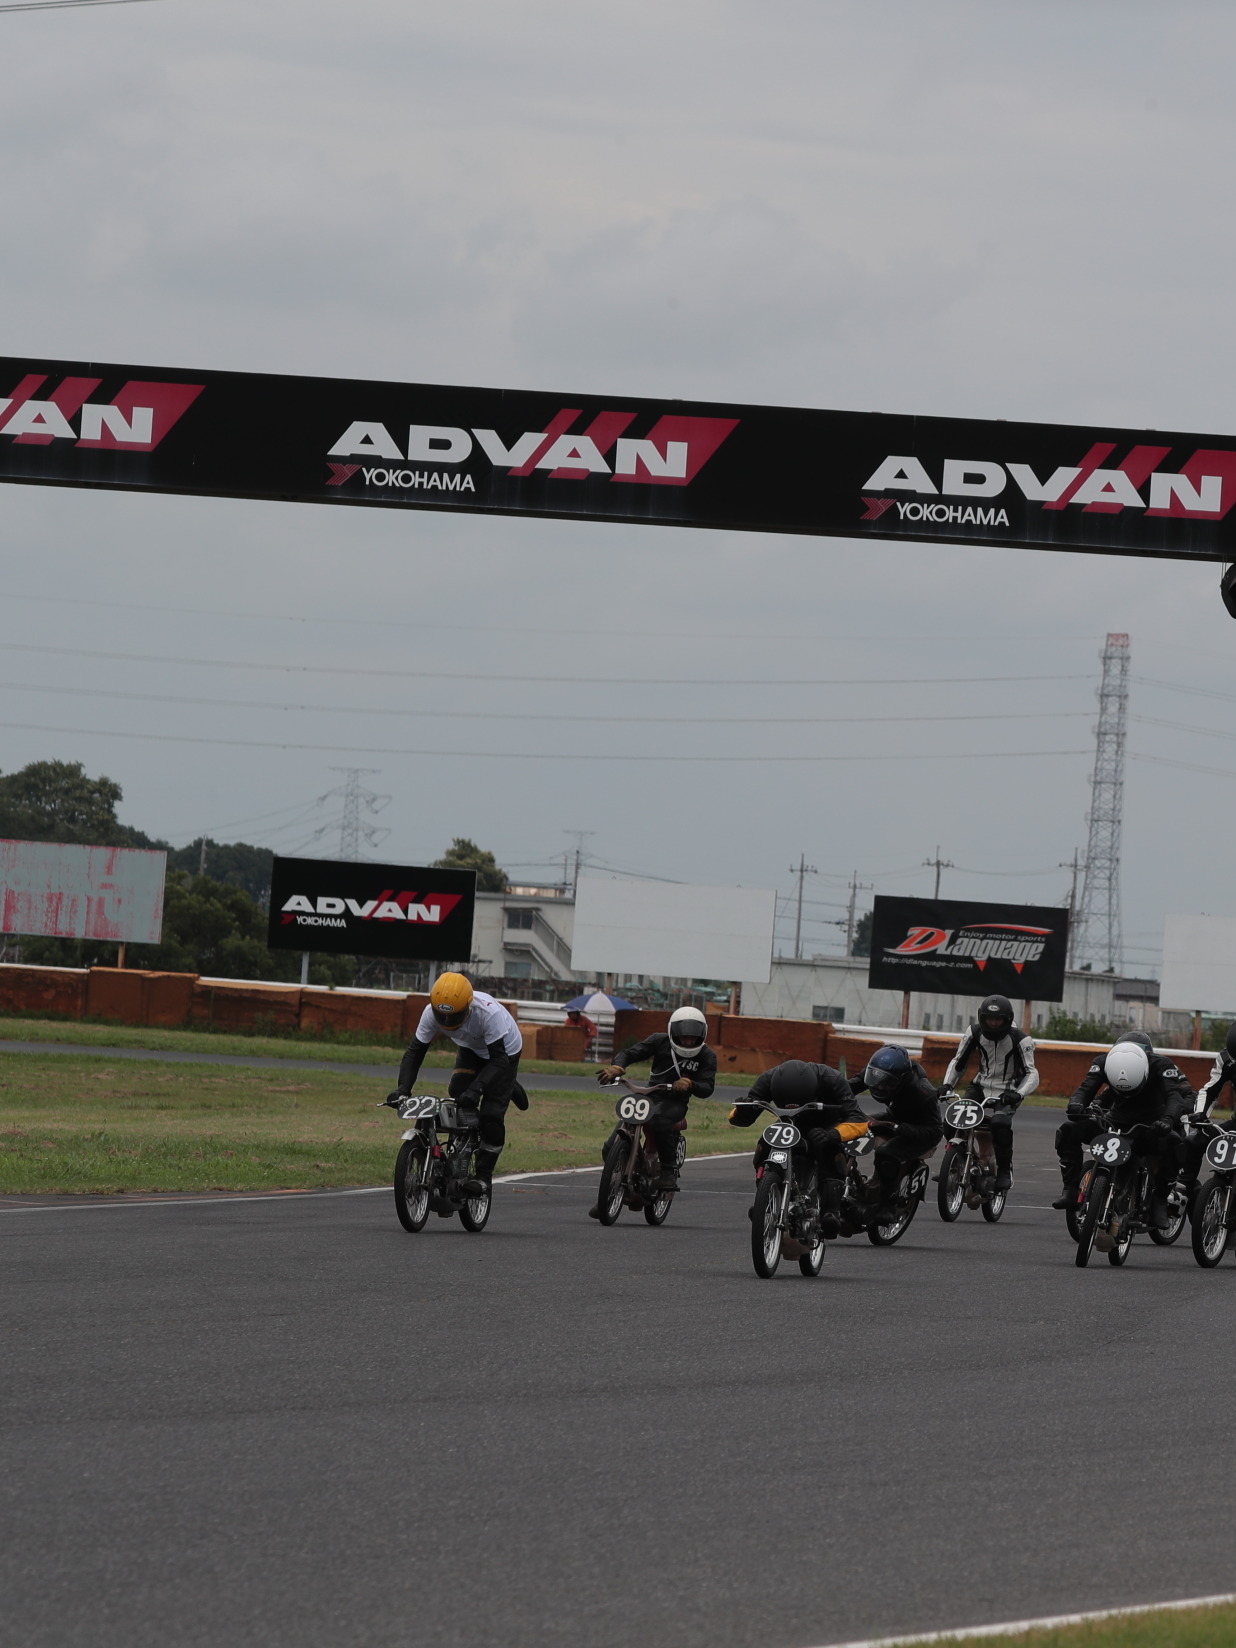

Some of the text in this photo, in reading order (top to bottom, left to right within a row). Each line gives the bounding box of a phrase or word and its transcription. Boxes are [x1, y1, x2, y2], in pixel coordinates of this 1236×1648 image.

[0, 398, 154, 444] AN
[326, 420, 689, 478] ADVAN
[361, 467, 476, 492] YOKOHAMA
[861, 455, 1223, 513] ADVAN
[896, 501, 1010, 527] YOKOHAMA
[281, 894, 441, 922] ADVAN
[296, 915, 347, 928] YOKOHAMA
[959, 930, 985, 938] Enjoy
[402, 1098, 435, 1119] 22
[620, 1097, 650, 1120] 69
[952, 1105, 978, 1125] 75
[770, 1125, 795, 1145] 79
[1091, 1138, 1121, 1162] #8
[910, 1169, 927, 1194] 51
